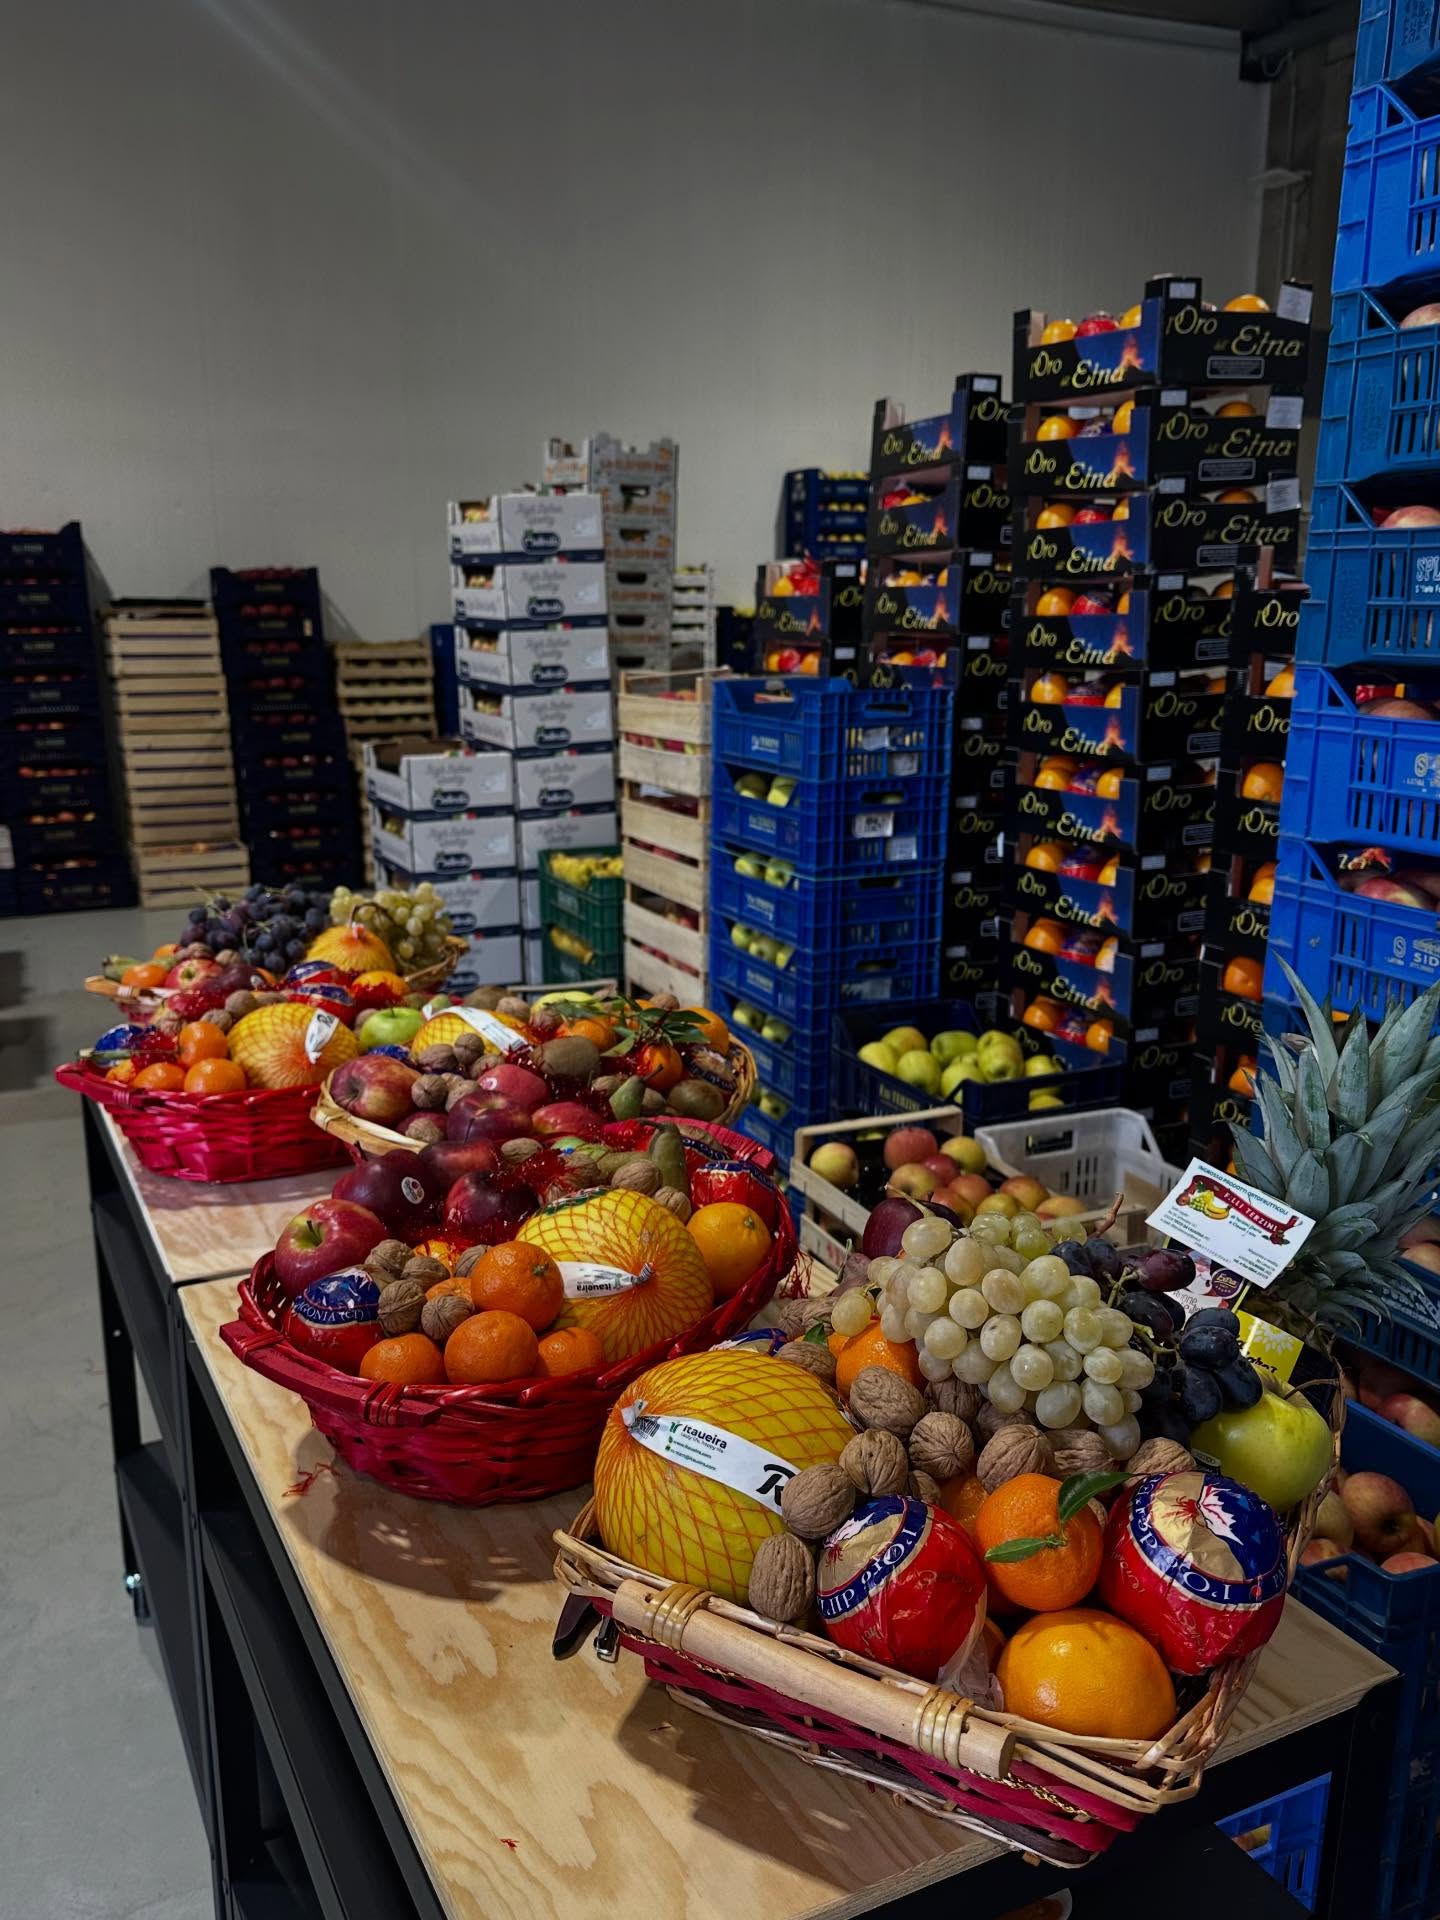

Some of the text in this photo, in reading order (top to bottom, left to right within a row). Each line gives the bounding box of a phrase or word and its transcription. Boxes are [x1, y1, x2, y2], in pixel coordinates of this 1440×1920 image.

[1230, 325, 1302, 358] Etna
[1221, 427, 1294, 458] Etna
[1220, 514, 1292, 544] Etna
[1197, 1165, 1289, 1215] INGROSSO PRODOTTI ORTOFRUTTICOLI
[1242, 1207, 1280, 1231] TERZINI
